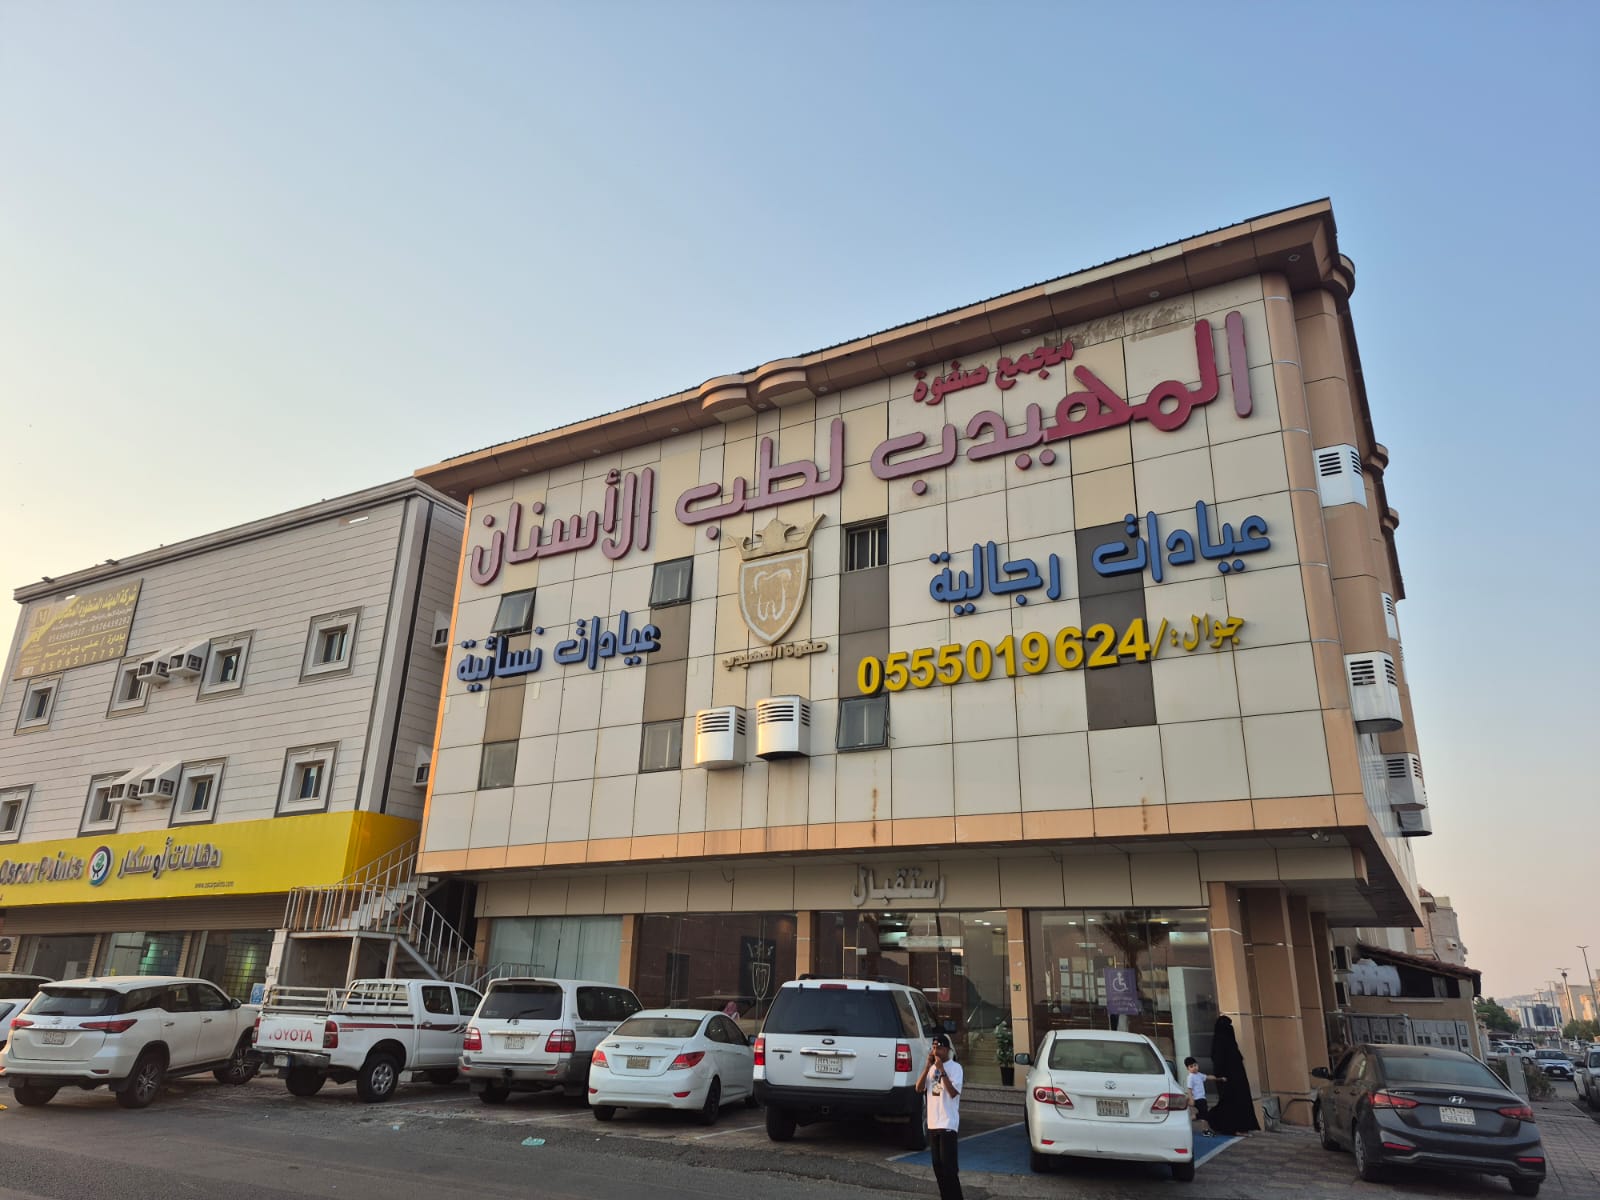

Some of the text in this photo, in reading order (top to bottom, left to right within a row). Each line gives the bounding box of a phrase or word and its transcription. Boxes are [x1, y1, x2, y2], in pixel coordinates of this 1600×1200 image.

[912, 339, 1075, 406] مجمع صفوة
[470, 310, 1254, 586] المهيدب لطب الأسنان
[929, 500, 1271, 616] عيادات رجالية
[456, 610, 662, 692] عيادات نسائية
[856, 617, 1151, 697] 0555019624
[168, 842, 223, 871] دهانات
[850, 866, 946, 907] استقبال
